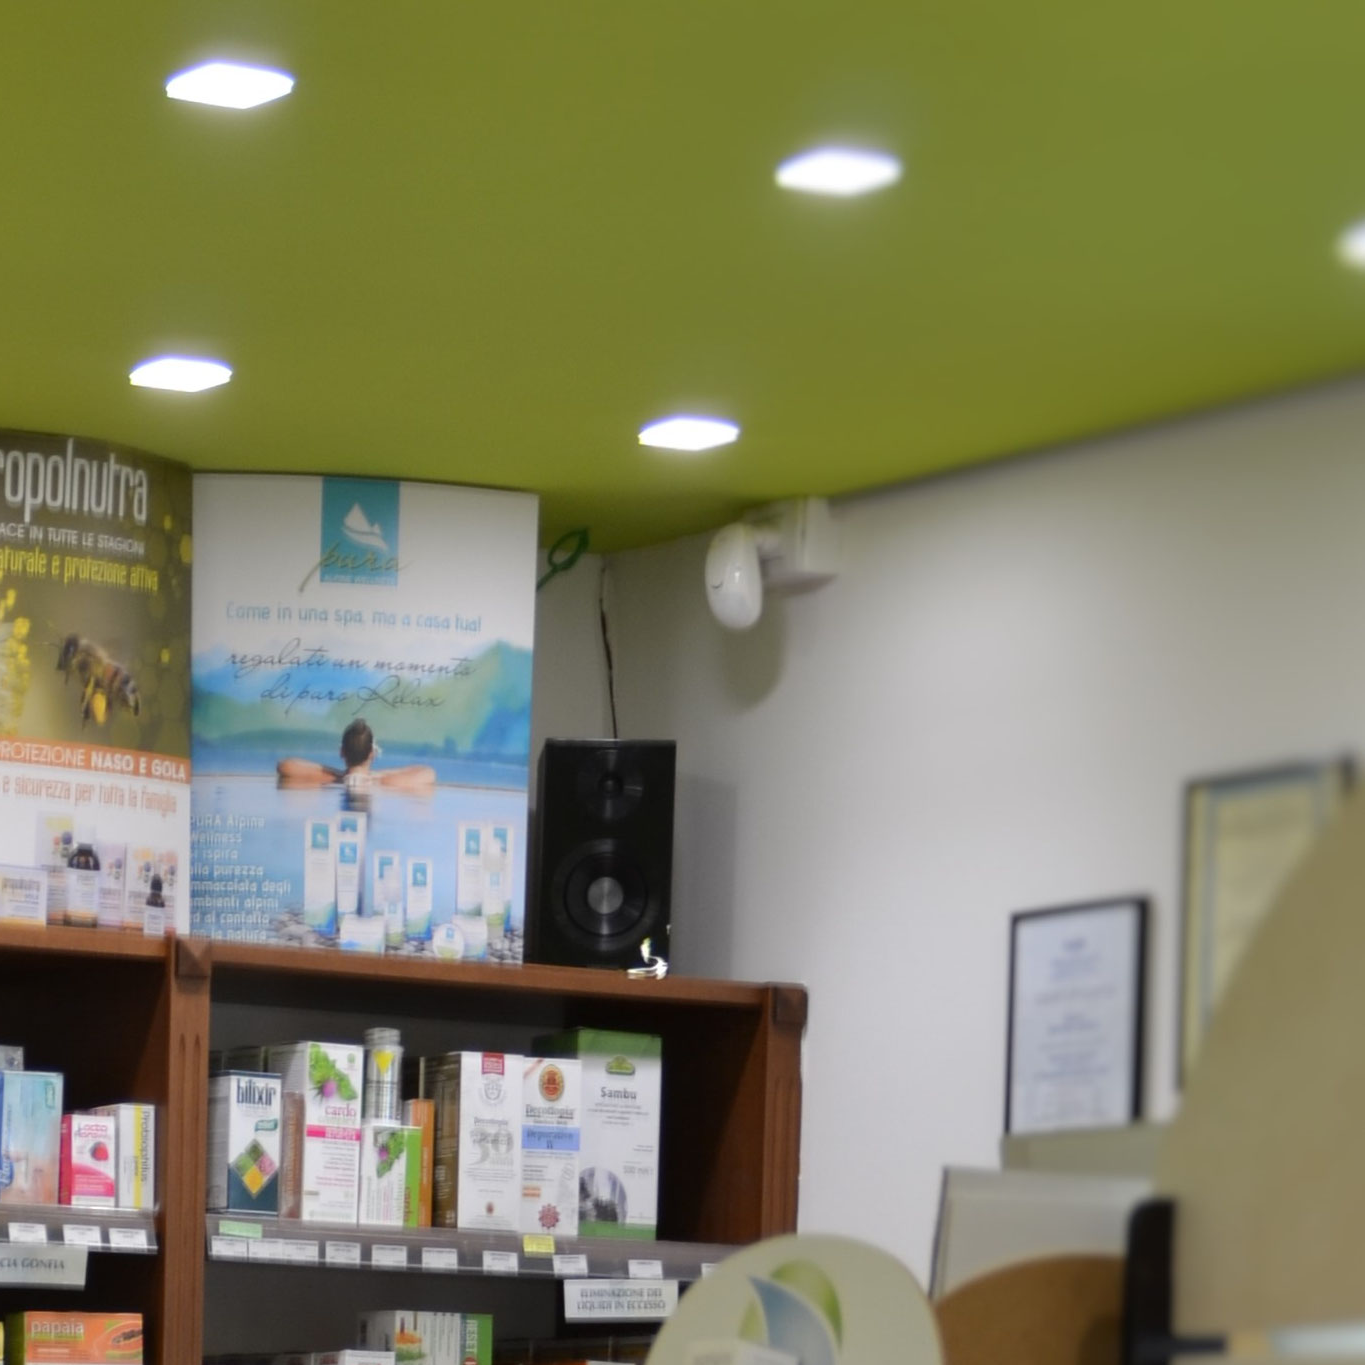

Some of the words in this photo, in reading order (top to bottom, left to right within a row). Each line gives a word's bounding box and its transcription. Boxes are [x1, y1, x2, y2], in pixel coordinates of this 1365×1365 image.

[29, 525, 43, 540] IN
[47, 527, 78, 545] TUTTE
[226, 601, 271, 622] Come
[277, 603, 293, 622] in
[299, 605, 329, 624] una
[372, 609, 397, 626] ma
[417, 614, 450, 631] casa
[91, 753, 133, 772] NASO
[139, 757, 147, 774] E
[151, 758, 187, 780] GOLA
[191, 880, 257, 892] mmacolata
[191, 896, 239, 908] mbienti
[600, 1086, 638, 1101] Sambu
[31, 1319, 84, 1340] papaia
